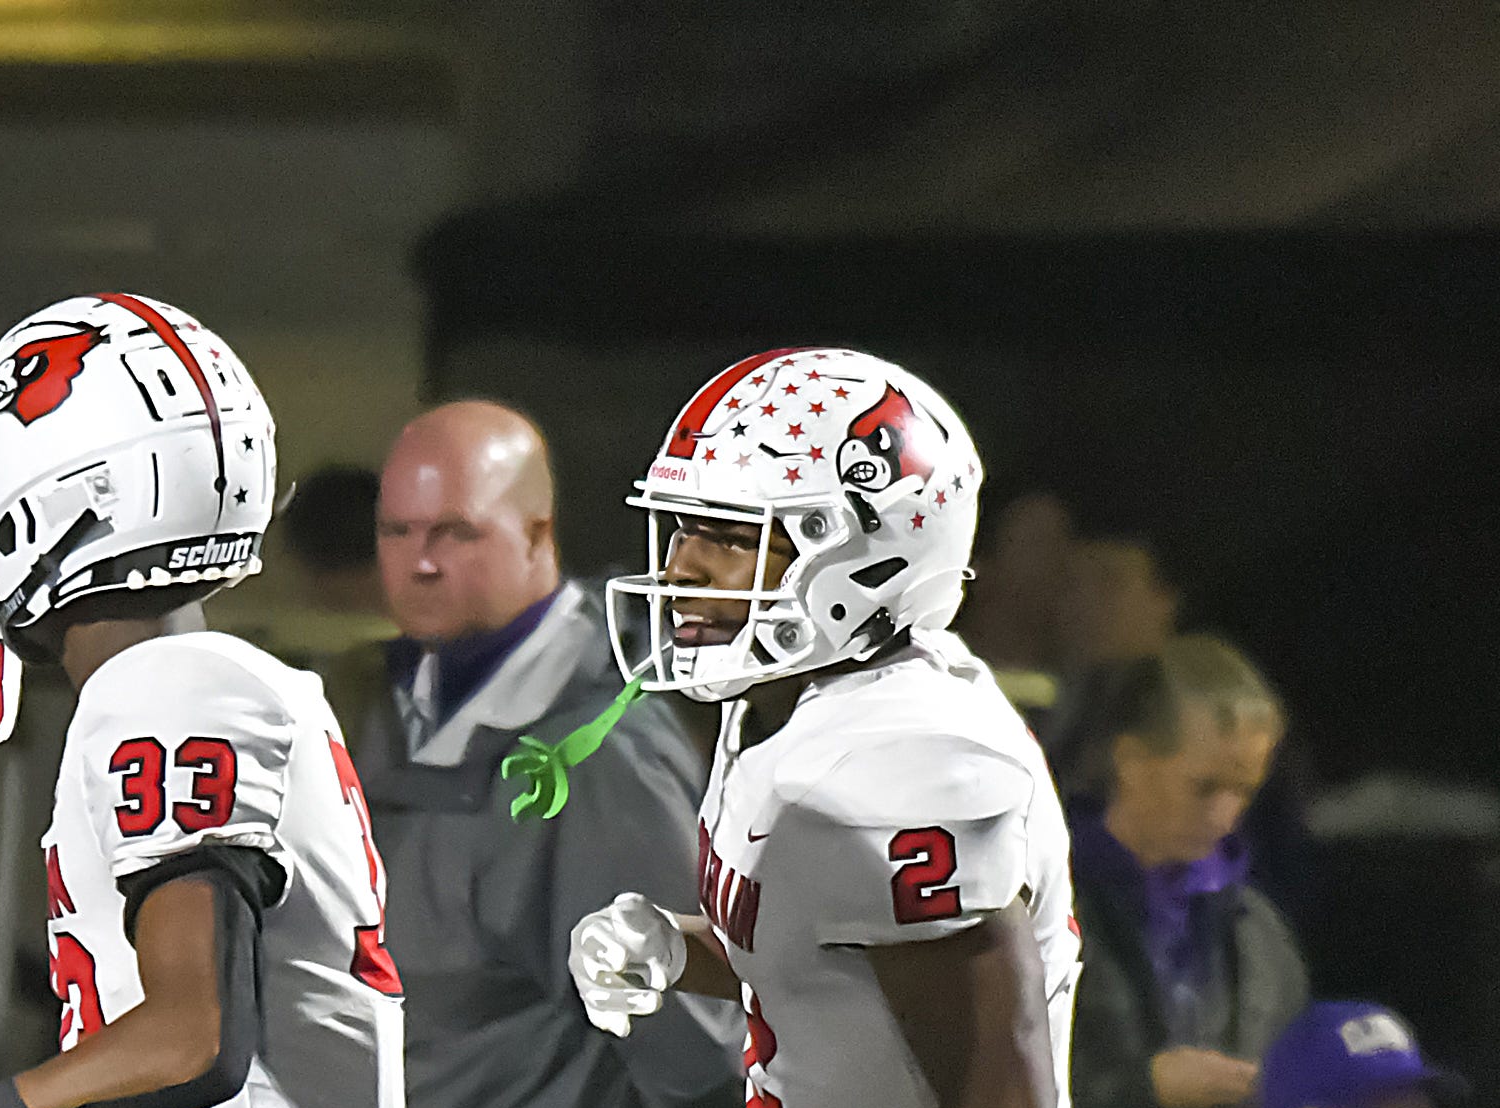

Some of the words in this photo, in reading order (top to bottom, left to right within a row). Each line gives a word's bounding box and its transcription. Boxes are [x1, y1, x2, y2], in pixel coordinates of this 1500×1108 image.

[169, 537, 252, 569] schutt
[108, 736, 238, 838] 33
[888, 825, 963, 926] 2
